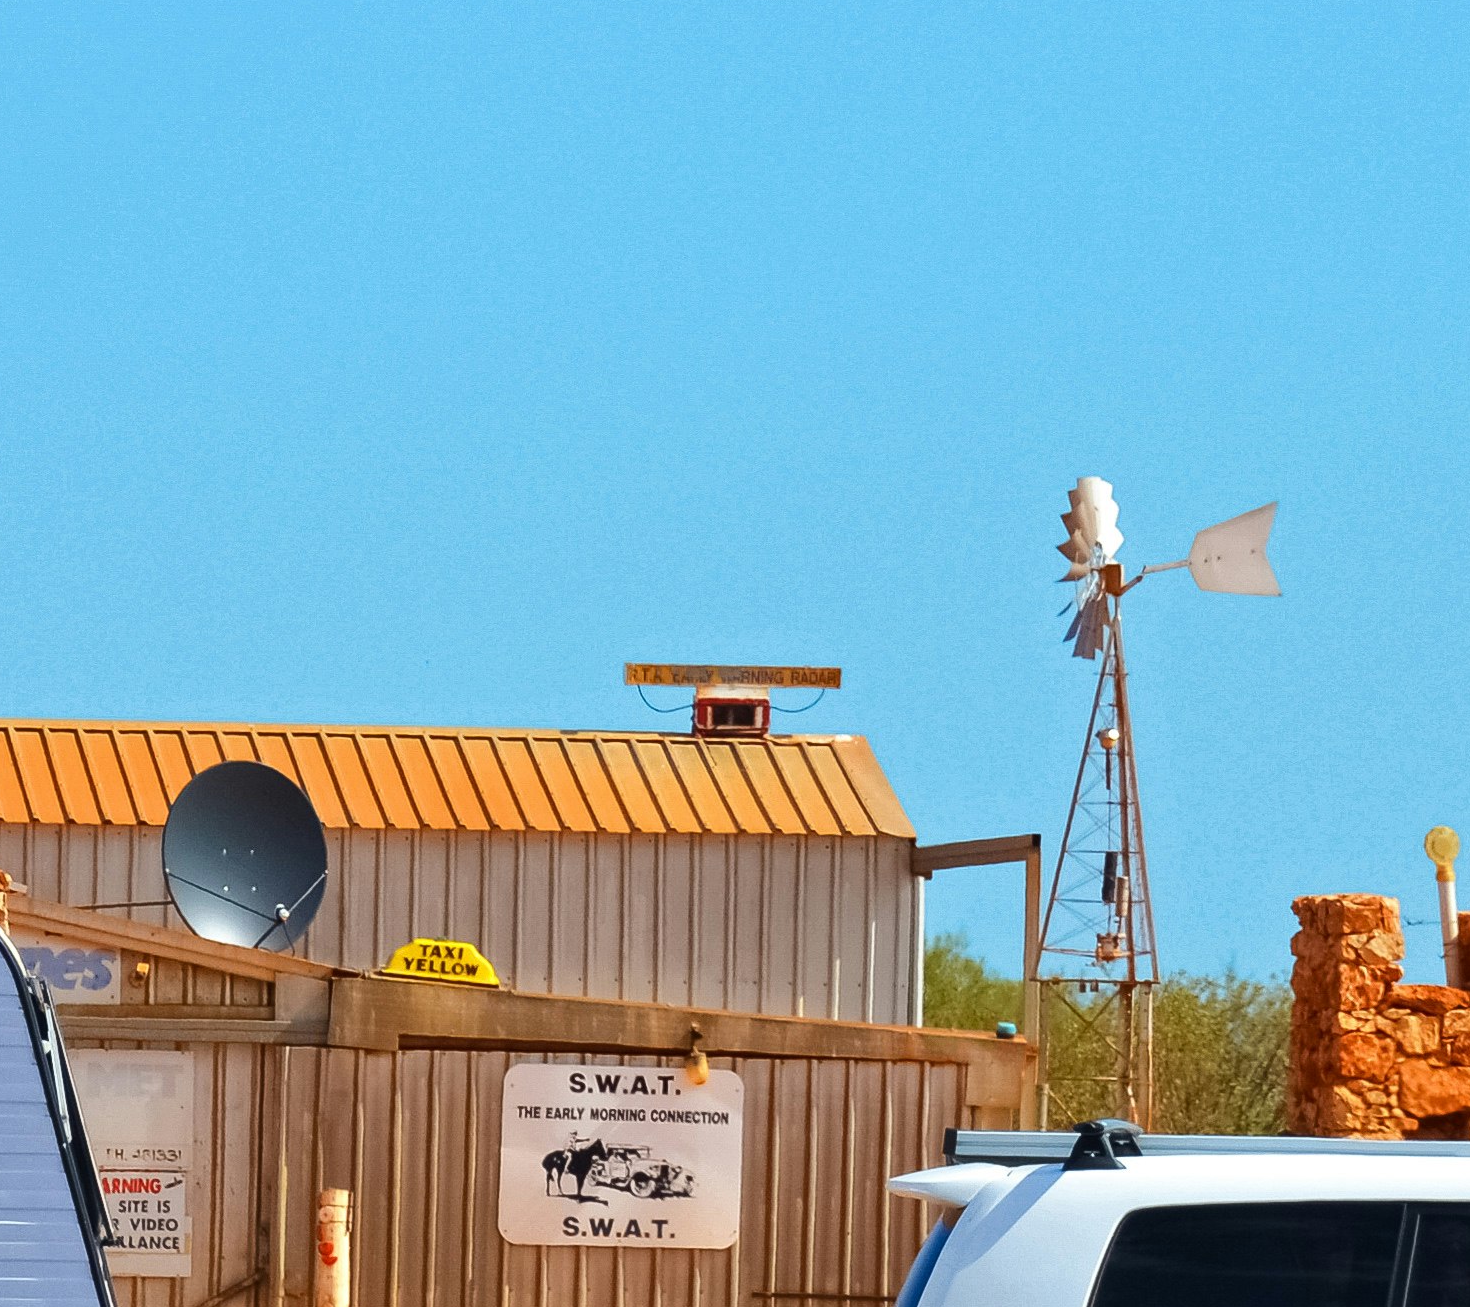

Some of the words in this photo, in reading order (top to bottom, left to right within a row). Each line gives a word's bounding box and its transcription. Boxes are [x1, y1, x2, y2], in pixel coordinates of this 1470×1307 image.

[419, 944, 464, 960] TAXI
[403, 957, 479, 976] YELLOW
[568, 1072, 682, 1096] S.W.A.T.
[517, 1105, 541, 1119] THE
[545, 1106, 585, 1121] EARLY
[590, 1108, 646, 1122] MORNING
[650, 1109, 729, 1124] CONNECTION
[102, 1177, 162, 1194] ARNING
[118, 1200, 149, 1213] SITE
[157, 1200, 171, 1213] IS
[130, 1218, 179, 1232] VIDEO
[562, 1216, 676, 1239] S.W.A.T.
